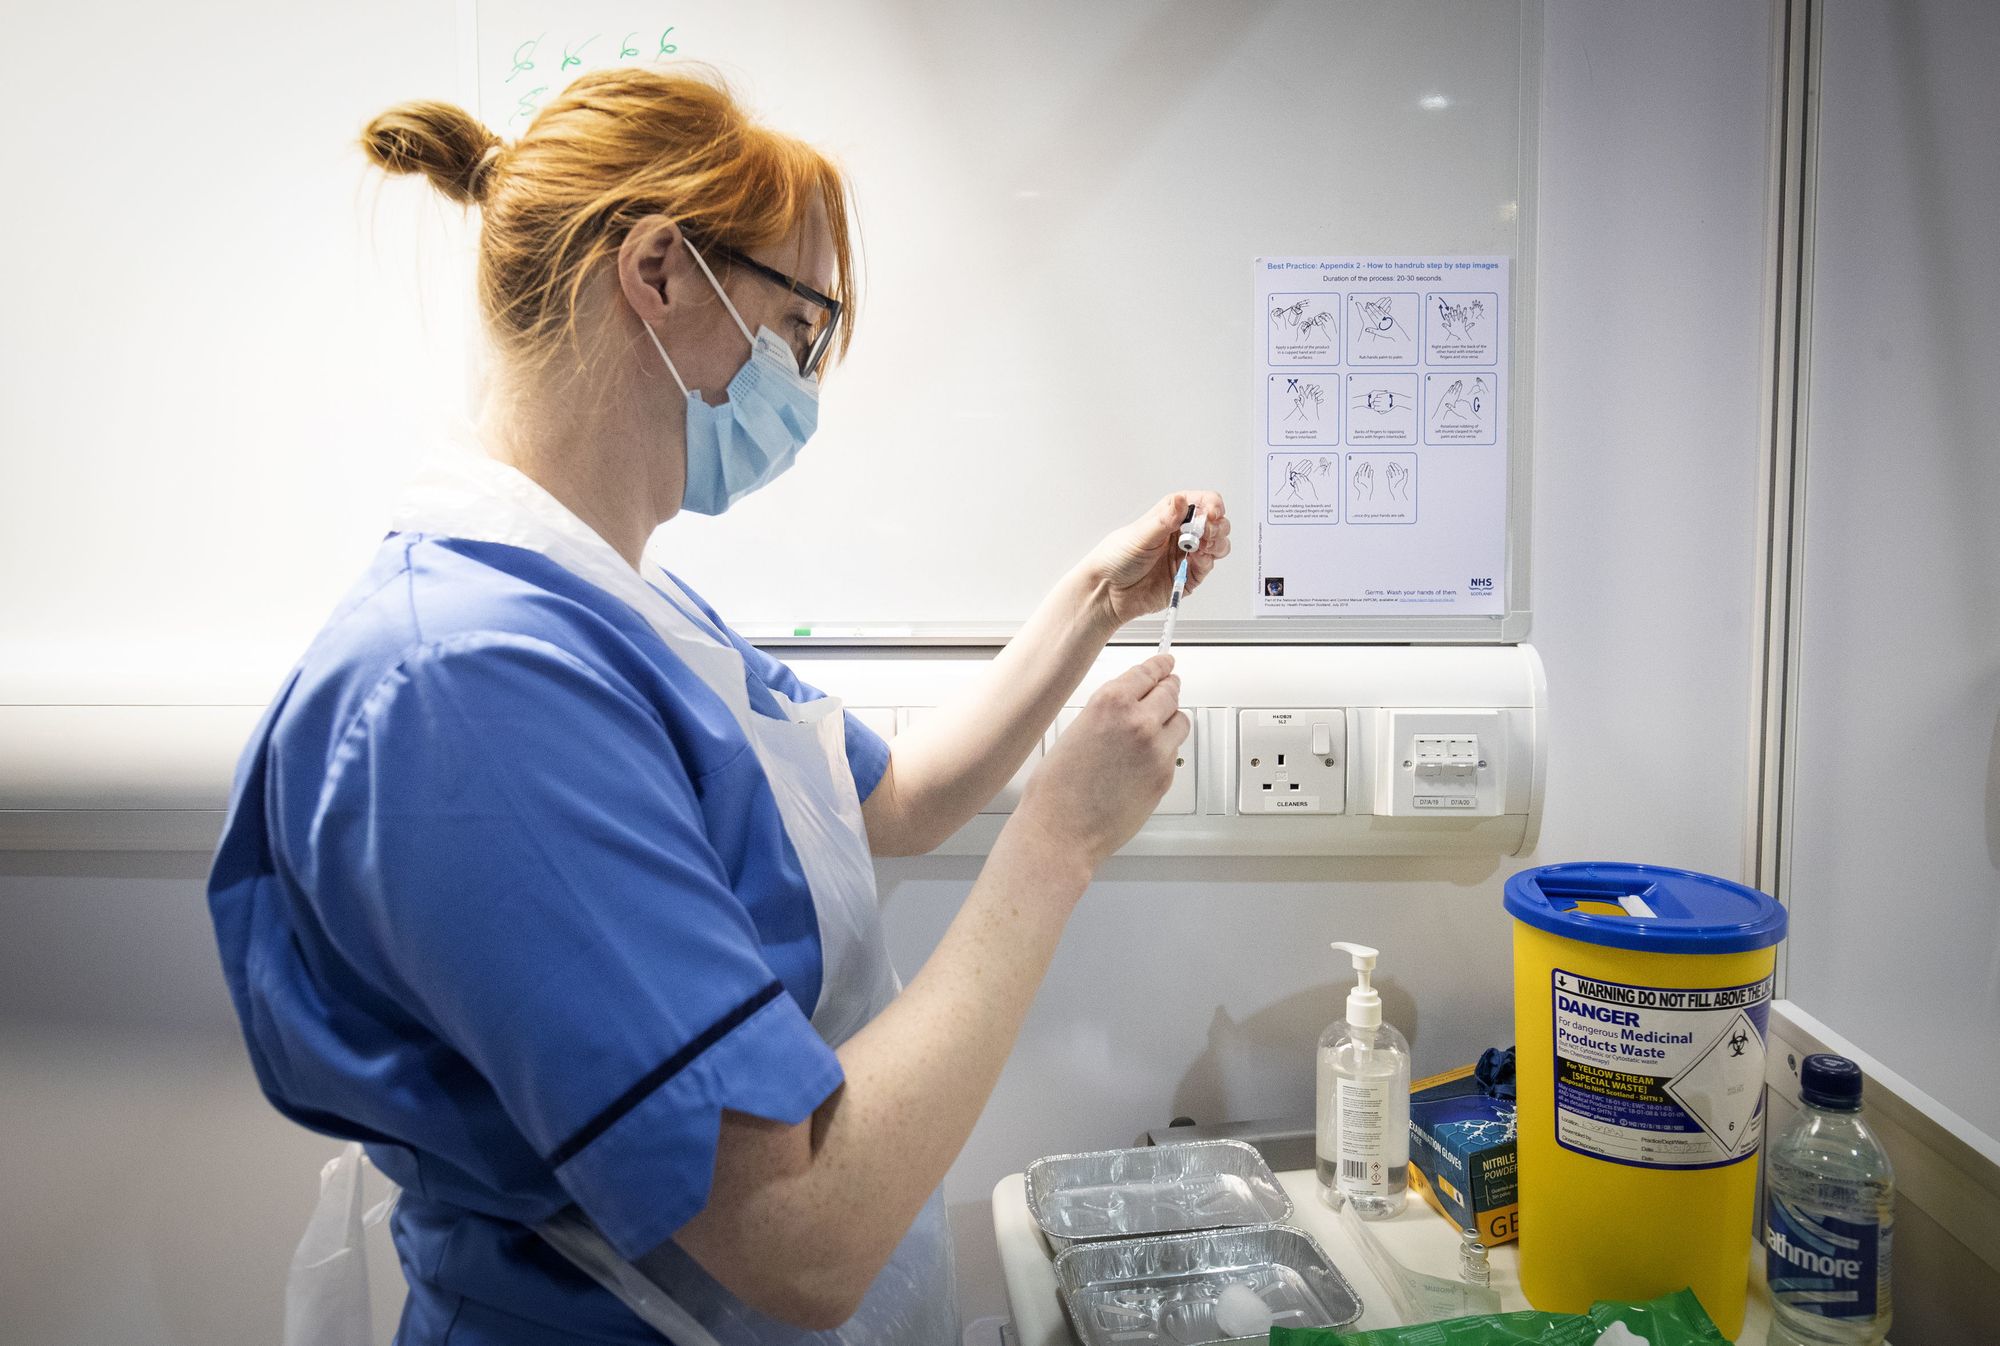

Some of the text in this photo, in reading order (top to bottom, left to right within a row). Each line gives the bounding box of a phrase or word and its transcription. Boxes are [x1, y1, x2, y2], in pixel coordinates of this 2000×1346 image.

[620, 32, 639, 59] 6
[655, 27, 677, 62] 6
[1320, 262, 1354, 270] Appendix
[1426, 262, 1443, 270] step
[1444, 262, 1453, 270] by
[1455, 262, 1471, 270] step
[1472, 262, 1499, 270] images
[1470, 578, 1492, 586] NHS
[1578, 979, 1635, 1004] WARNING
[1638, 990, 1656, 1006] DO
[1660, 993, 1686, 1007] NOT
[1688, 993, 1712, 1008] FILL
[1713, 989, 1745, 1007] ABOVE
[1747, 986, 1761, 1001] THE
[1558, 995, 1640, 1028] DANGER
[1559, 1016, 1692, 1044] For dangerous Medicinal
[1559, 1027, 1666, 1059] Products Waste
[1569, 1042, 1579, 1050] NOT
[1580, 1046, 1605, 1058] Cytotoxic
[1570, 1048, 1610, 1065] Chemotherapy)
[1566, 1061, 1654, 1086] For YELLOW STREAM
[1572, 1071, 1648, 1095] [SPECIAL WASTE]
[1560, 1077, 1584, 1088] disposal
[1591, 1085, 1606, 1093] NHS
[1606, 1089, 1635, 1100] Scotland
[1568, 1088, 1591, 1099] comprise
[1570, 1093, 1588, 1103] Medical
[1590, 1100, 1613, 1110] Products
[1570, 1099, 1590, 1109] detailed
[1597, 1107, 1612, 1116] SHTN
[1561, 1116, 1578, 1126] Location
[1728, 1121, 1735, 1131] 6
[1409, 1119, 1462, 1170] EXAMINATION GLOVES
[1482, 1152, 1516, 1172] NITRILE
[1767, 1226, 1860, 1280] athmore
